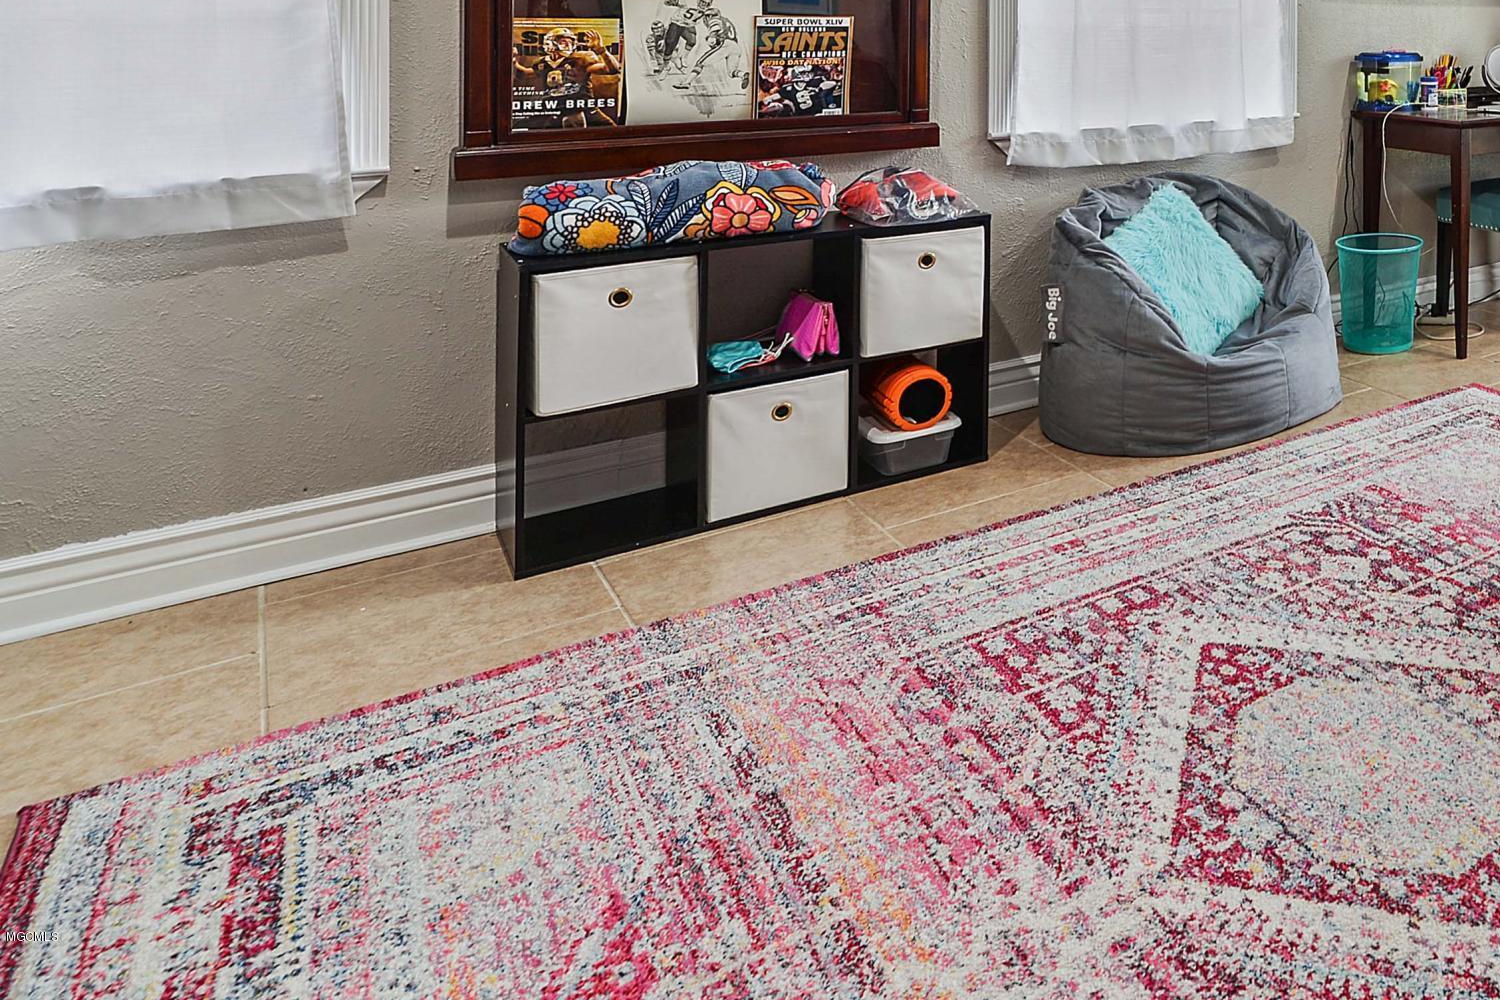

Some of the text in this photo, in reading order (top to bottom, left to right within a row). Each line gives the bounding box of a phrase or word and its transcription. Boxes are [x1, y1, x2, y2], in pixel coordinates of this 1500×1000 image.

[758, 31, 847, 53] SAINTS
[801, 50, 846, 58] CHAMPIONS
[512, 98, 616, 110] DREW BREES
[1045, 288, 1061, 340] Big Joe
